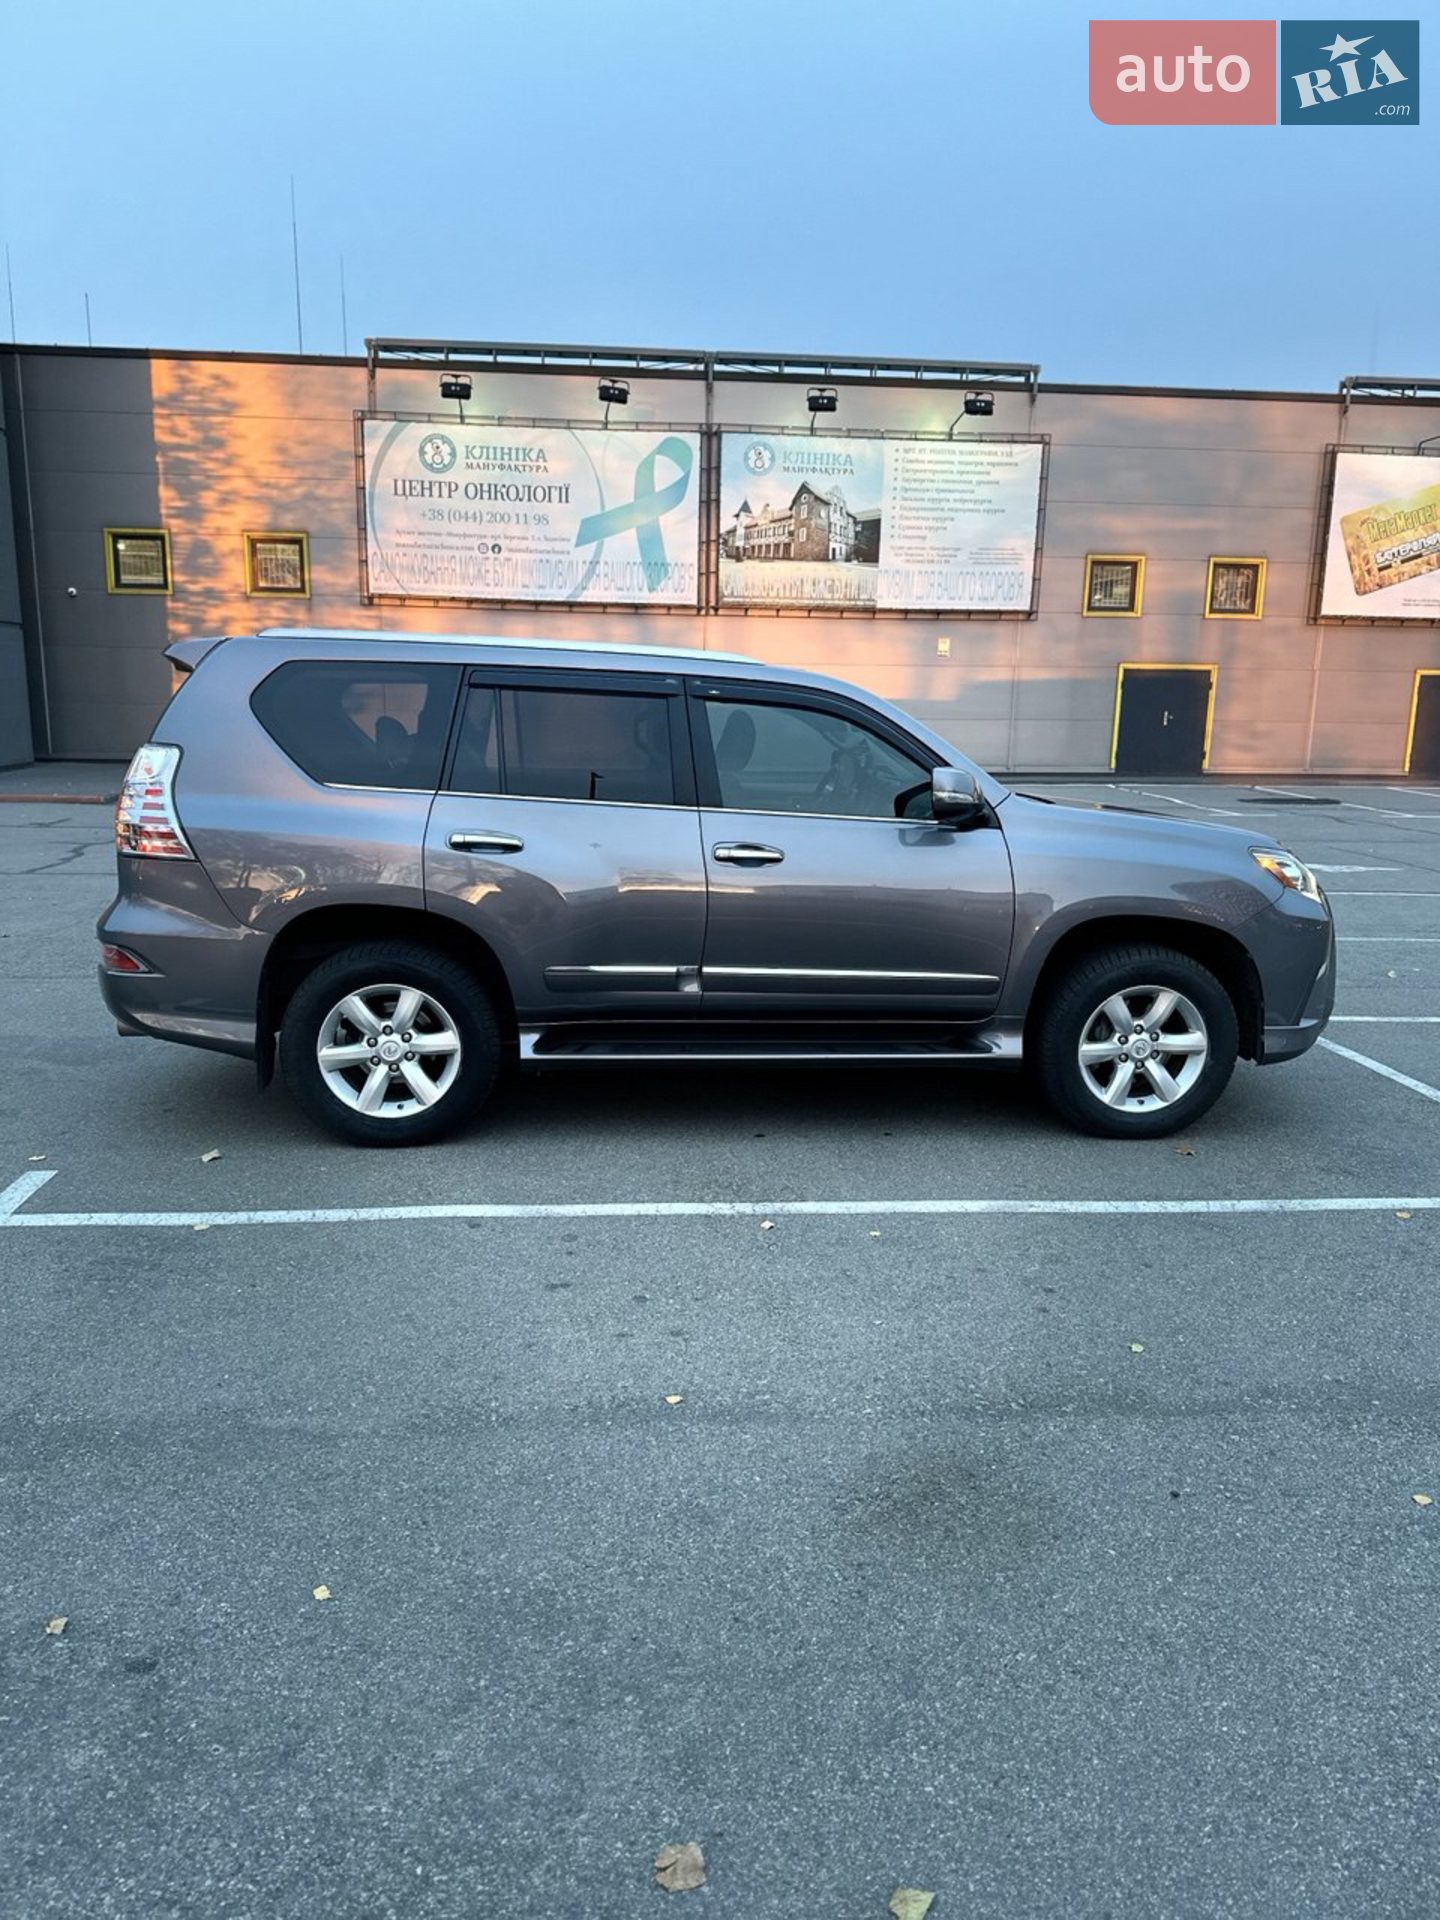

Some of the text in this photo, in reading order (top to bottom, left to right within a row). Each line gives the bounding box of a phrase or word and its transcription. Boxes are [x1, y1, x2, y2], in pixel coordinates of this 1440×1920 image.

[464, 445, 548, 463] КЛІНІКА
[783, 451, 853, 466] КЛІНІКА
[465, 462, 549, 473] МАНУФАКТУРА
[782, 465, 855, 476] МАНУФАКТУРА
[392, 478, 571, 504] ЦЕНТР ОНКОЛОГІЇ
[420, 509, 550, 526] +38 (044) 200 11 98
